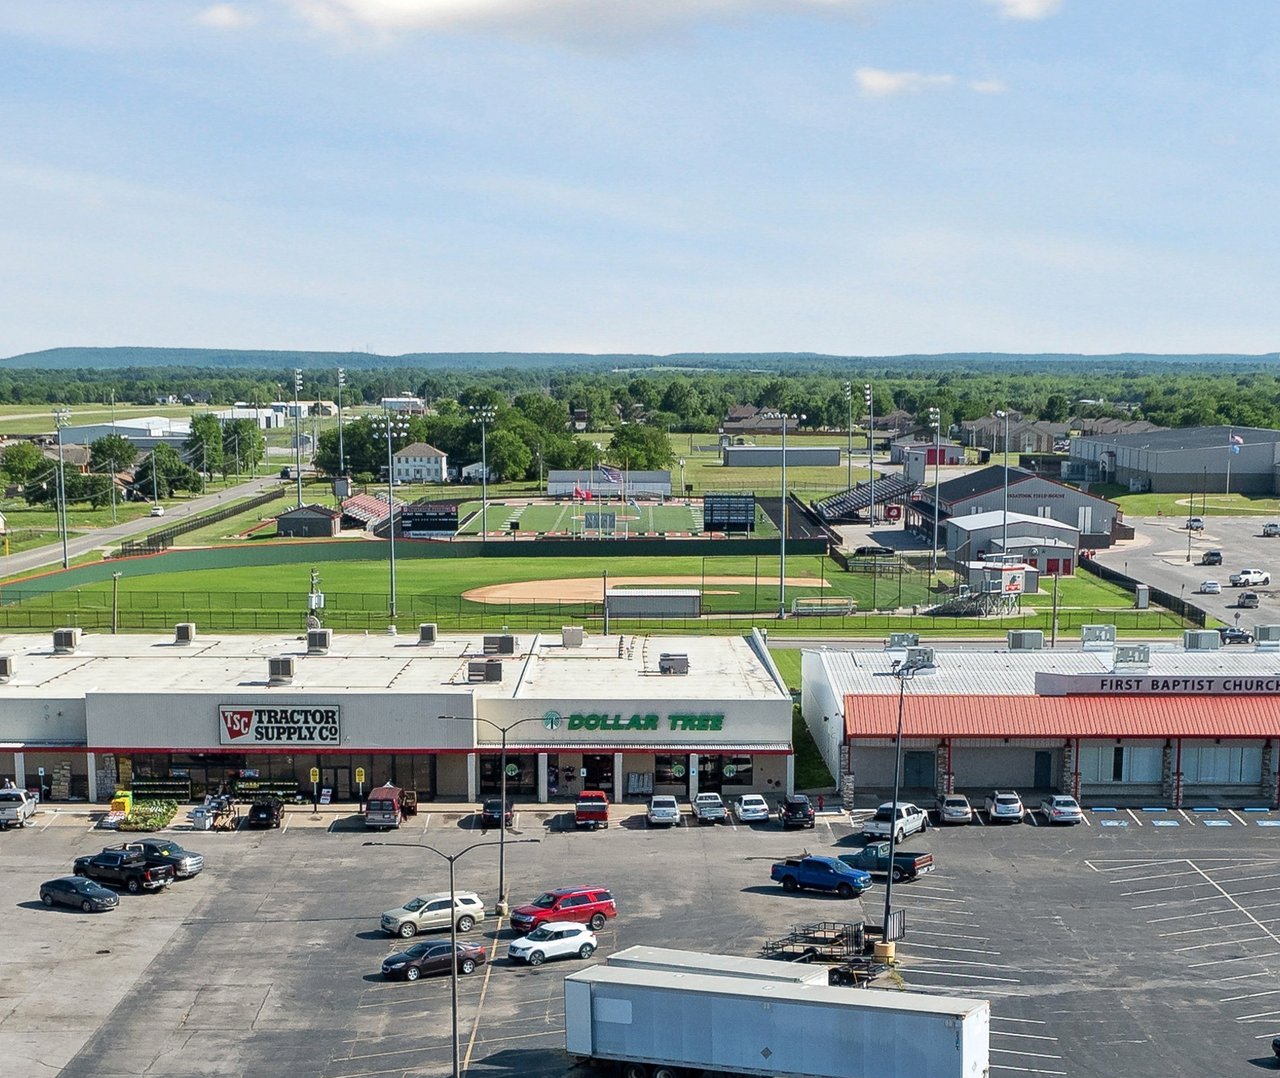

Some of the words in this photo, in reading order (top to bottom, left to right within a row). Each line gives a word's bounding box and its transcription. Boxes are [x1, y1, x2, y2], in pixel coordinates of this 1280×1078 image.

[1100, 679, 1142, 691] FIRST
[1151, 679, 1214, 691] BAPTIST
[225, 711, 248, 735] TSC
[254, 709, 337, 725] TRACTOR
[568, 714, 659, 731] DOLLAR
[668, 714, 724, 731] TREE
[254, 725, 317, 741] SUPPLY
